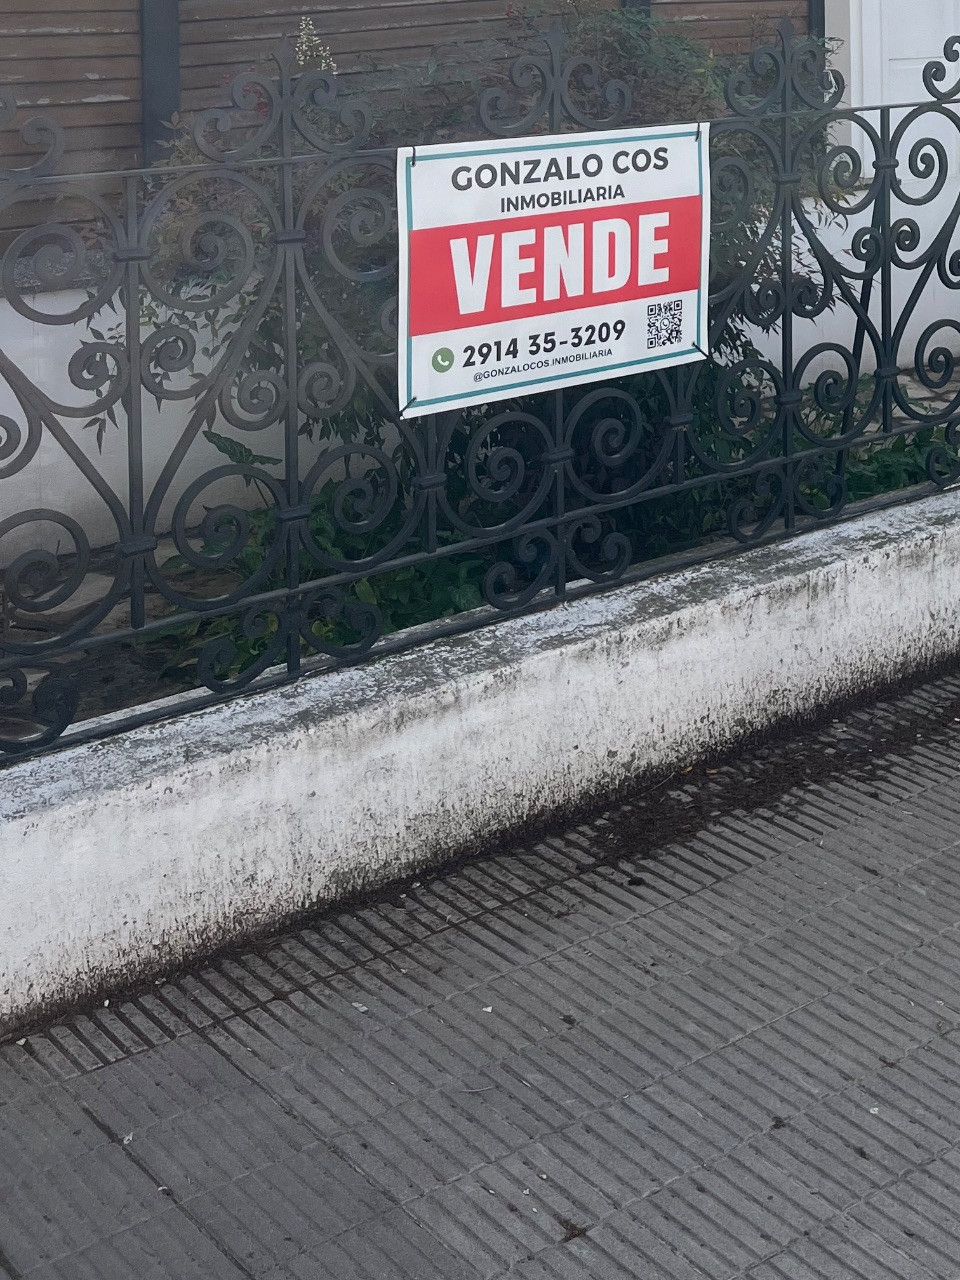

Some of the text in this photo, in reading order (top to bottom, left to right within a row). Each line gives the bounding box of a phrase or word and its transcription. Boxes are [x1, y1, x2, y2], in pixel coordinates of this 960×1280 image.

[451, 147, 669, 191] GONZALO COS
[500, 184, 625, 213] INMOBILIARIA
[449, 211, 670, 315] VENDE
[462, 319, 626, 368] 2914 35-3209
[473, 348, 613, 383] @GONZALOCOS.INMOBILIARIA
